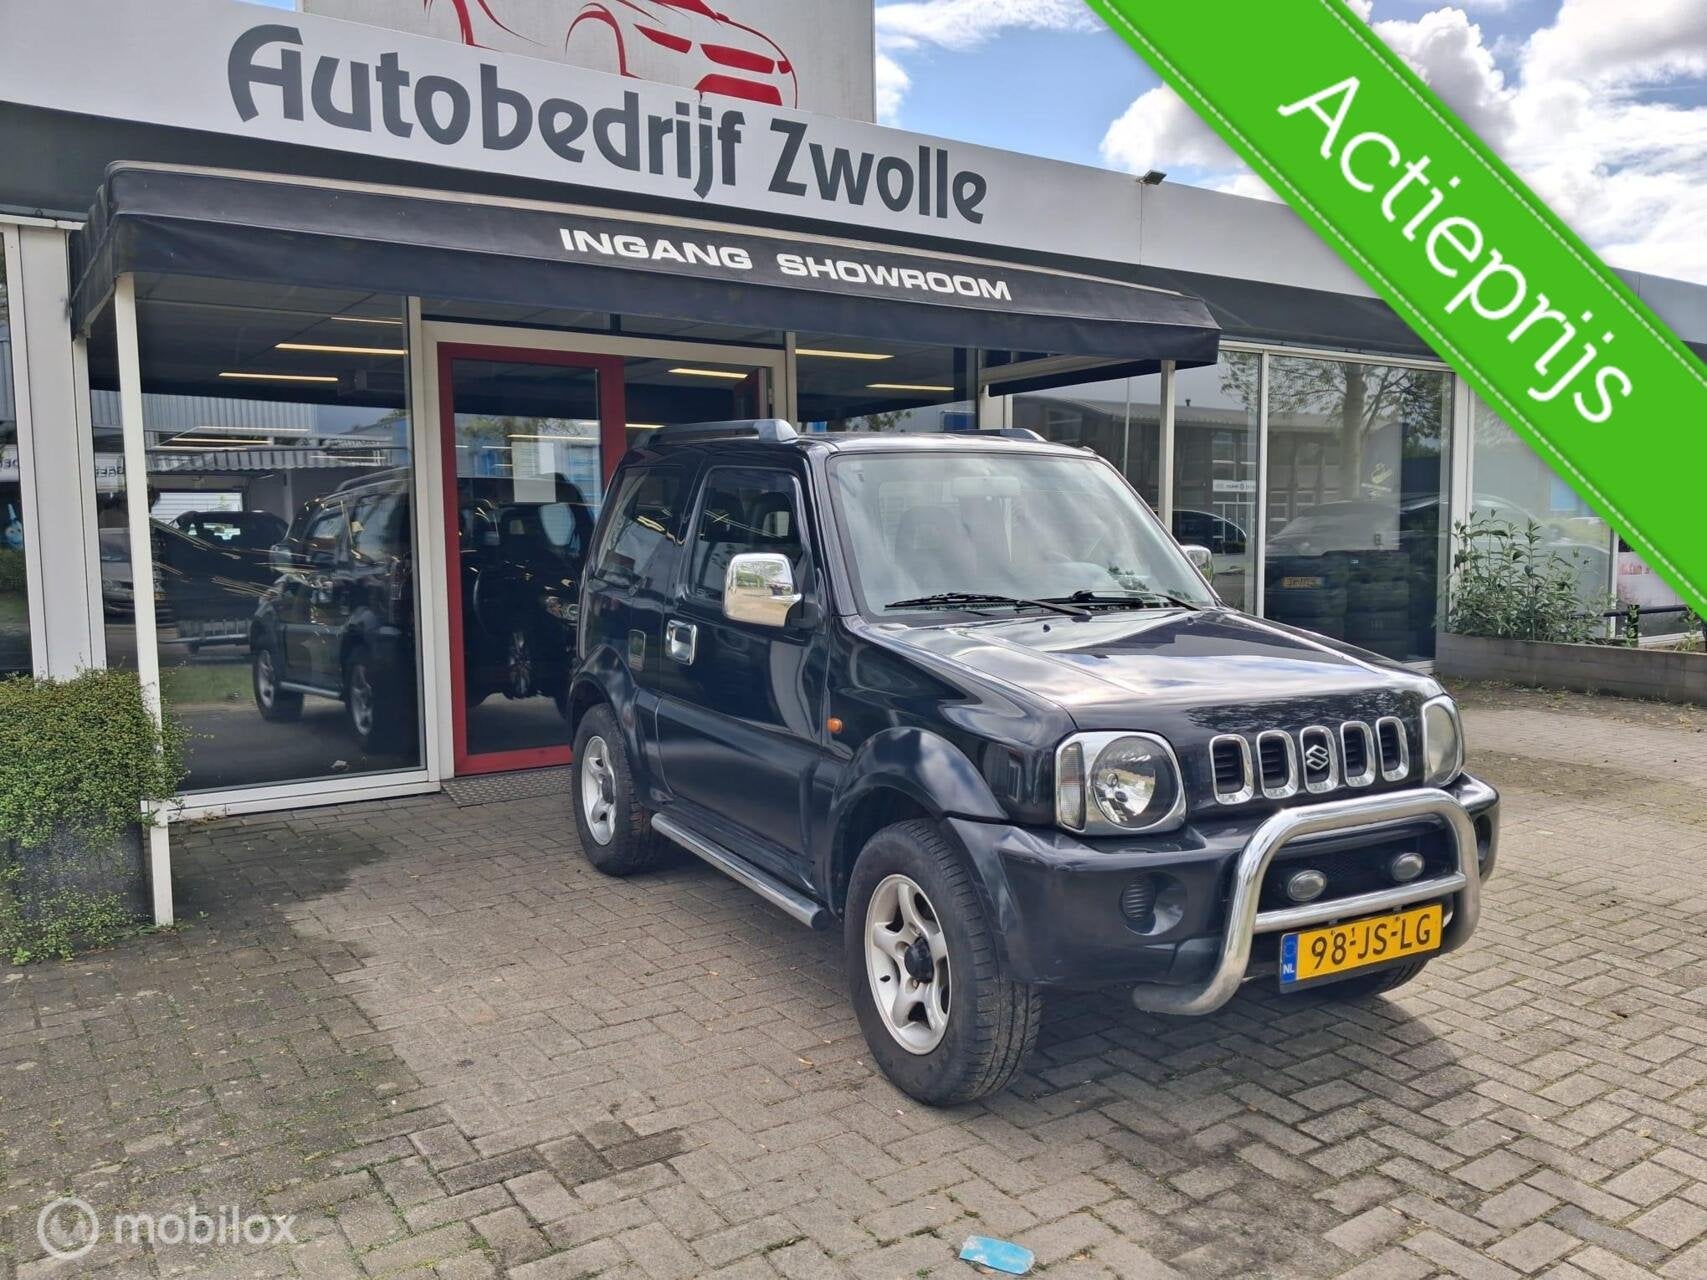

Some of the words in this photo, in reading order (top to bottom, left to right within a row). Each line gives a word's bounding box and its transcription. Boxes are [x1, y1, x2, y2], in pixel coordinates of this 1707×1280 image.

[228, 25, 745, 199] Autobedrijf
[768, 119, 988, 225] Zwolle
[559, 228, 753, 272] INGANG
[776, 254, 1013, 303] SHOWROOM
[1282, 964, 1295, 975] NL
[1311, 913, 1431, 970] 98-JS-LG
